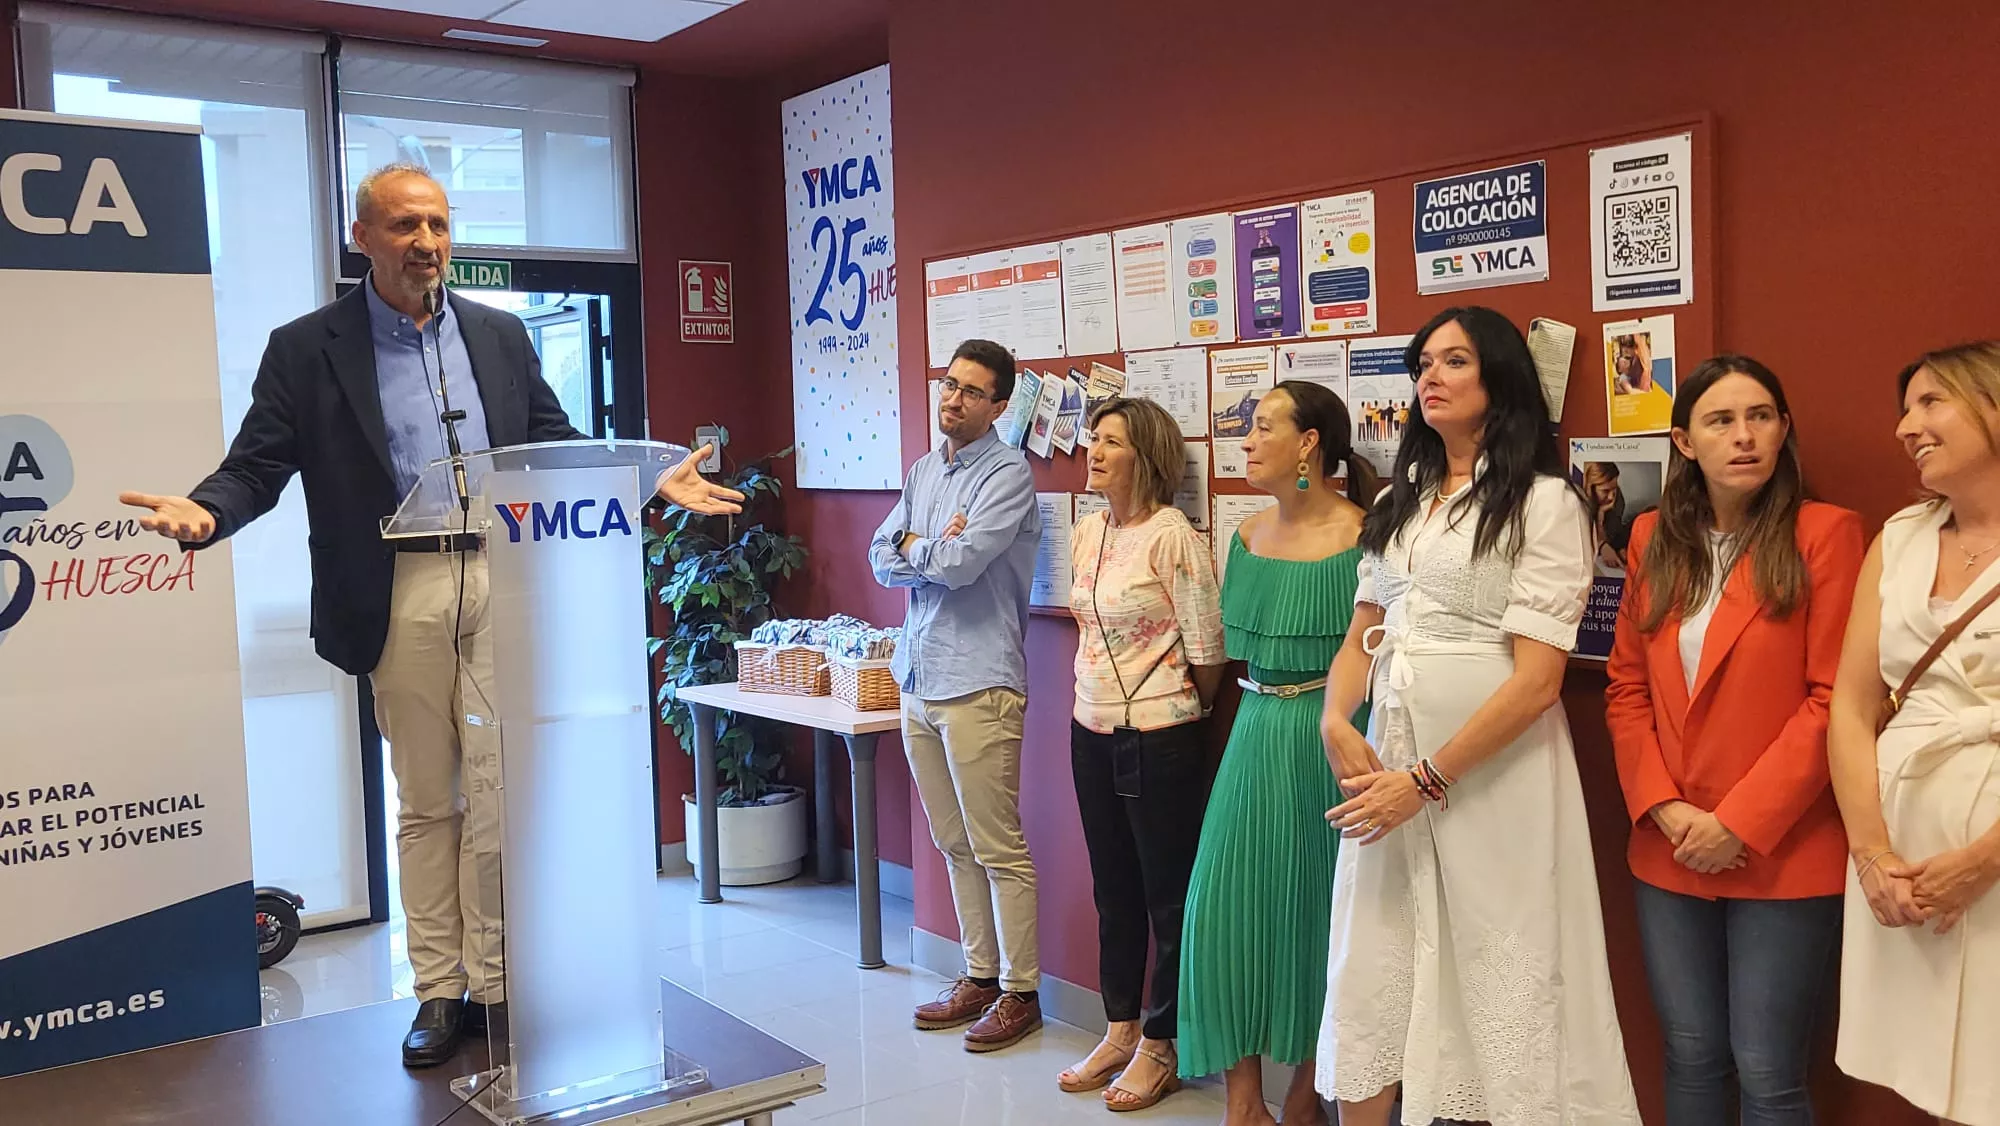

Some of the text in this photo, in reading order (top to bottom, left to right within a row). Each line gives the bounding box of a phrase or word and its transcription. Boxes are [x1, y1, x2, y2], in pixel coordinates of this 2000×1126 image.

[0, 152, 148, 237] CA
[802, 155, 882, 209] YMCA
[1425, 171, 1531, 210] AGENCIA DE
[1421, 194, 1537, 233] COLOCACIÓN
[1457, 226, 1511, 245] 9900000145
[1630, 228, 1652, 238] YMCA
[445, 264, 505, 286] ALIDA
[805, 216, 888, 331] 25 años
[1469, 245, 1536, 274] YMCA
[684, 322, 730, 336] EXTINTOR
[819, 335, 837, 354] 1999
[847, 333, 869, 351] 2024
[0, 441, 44, 482] A
[3, 518, 91, 550] años
[95, 517, 140, 541] en
[494, 498, 632, 543] YMCA
[40, 549, 195, 601] HUESCA
[1590, 583, 1620, 597] poyar
[1581, 621, 1599, 632] sus
[28, 781, 95, 806] PARA
[42, 813, 68, 832] EL
[75, 793, 206, 827] POTENCIAL
[78, 836, 93, 853] Y
[99, 820, 203, 851] JÓVENES
